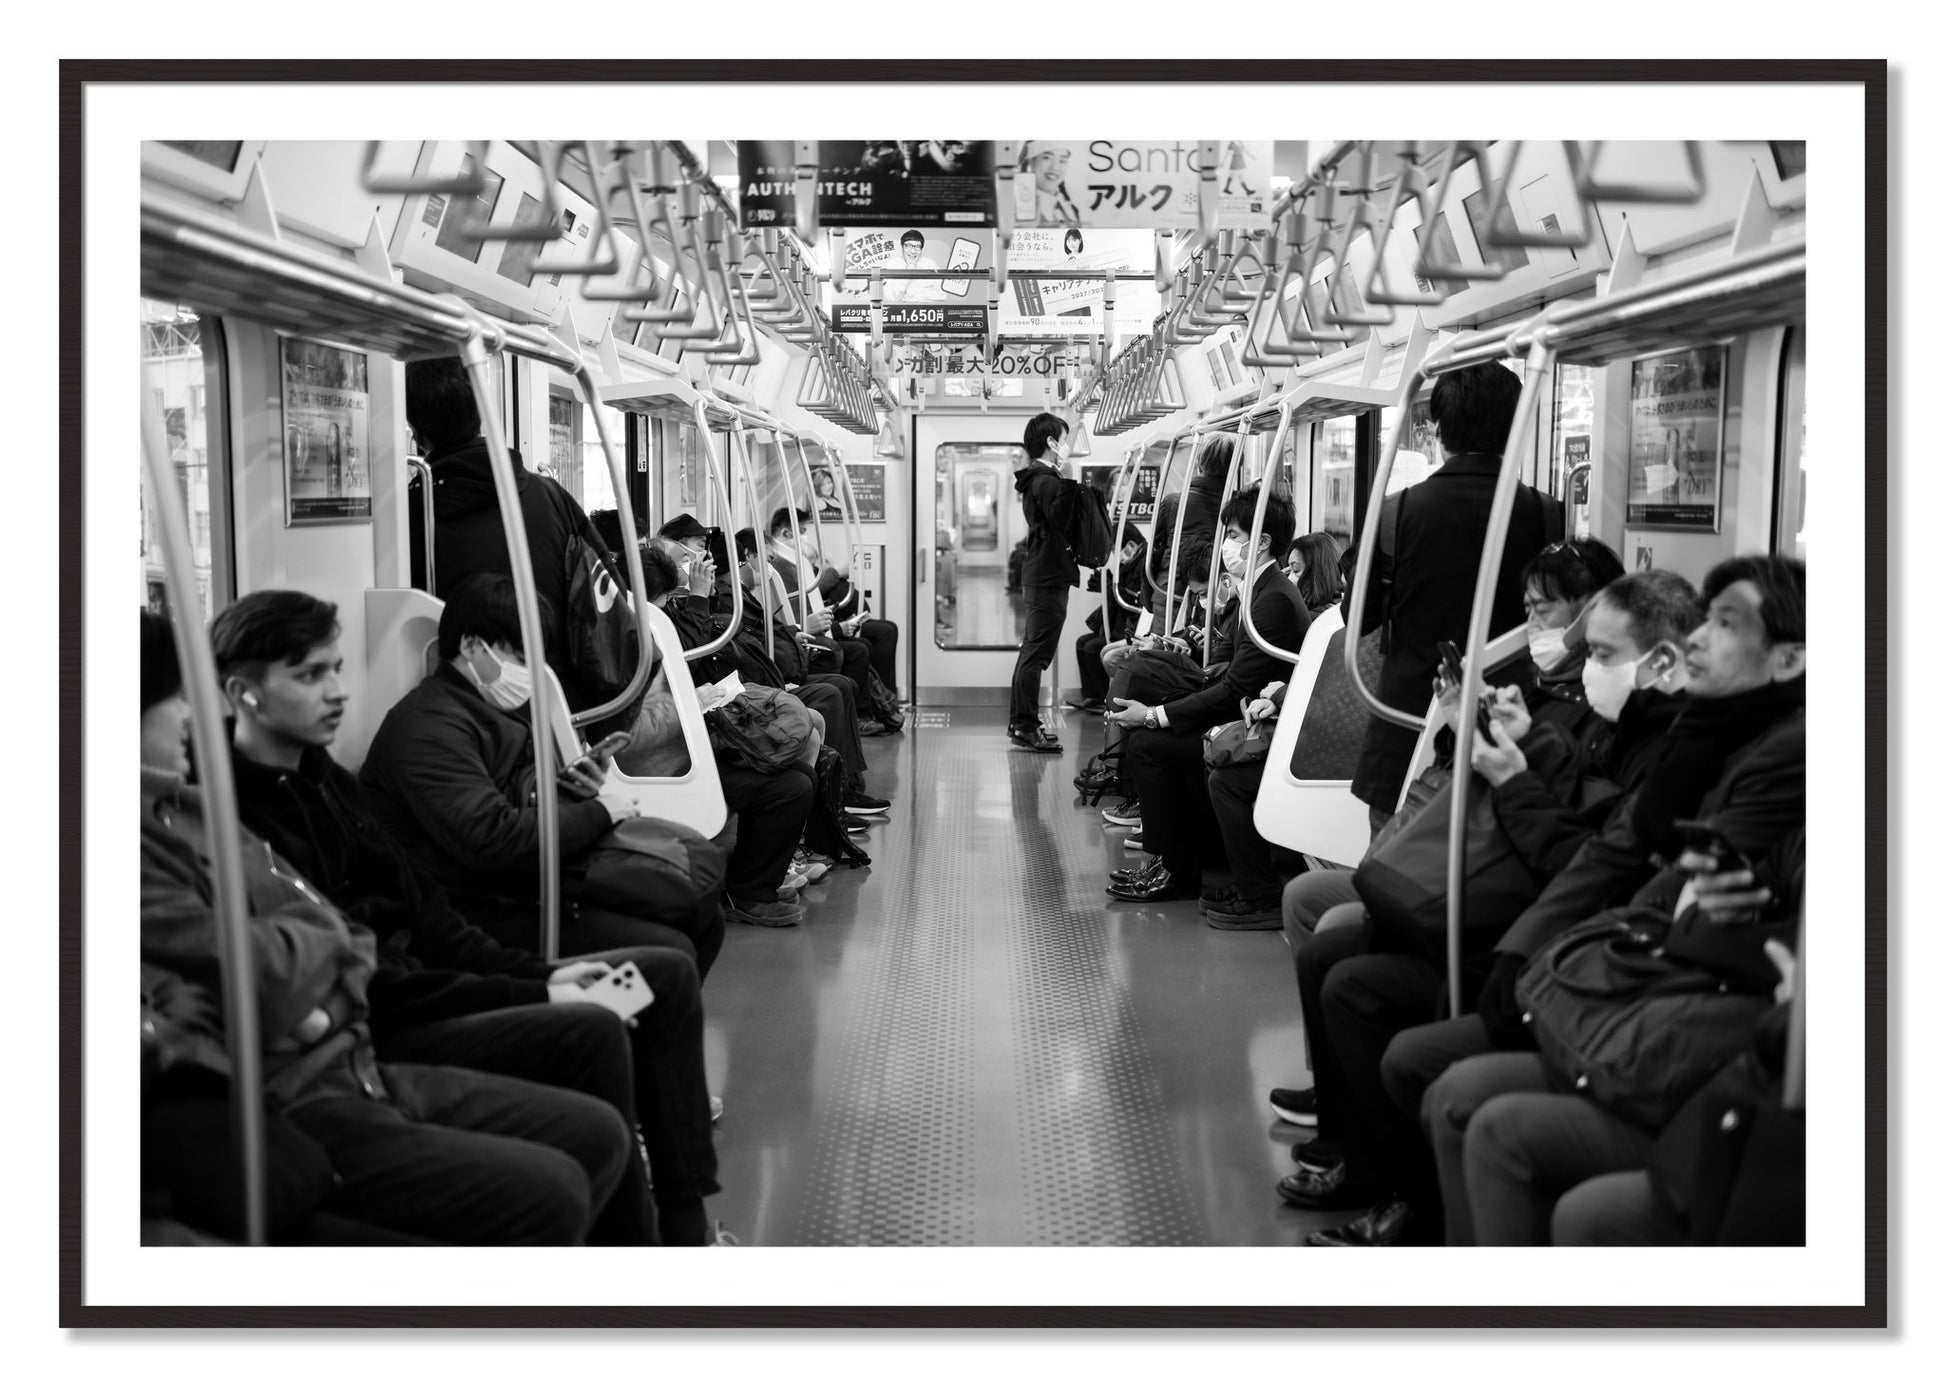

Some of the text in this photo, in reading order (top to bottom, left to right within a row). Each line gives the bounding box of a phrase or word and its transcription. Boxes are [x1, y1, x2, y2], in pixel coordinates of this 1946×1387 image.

[747, 182, 872, 196] AUTHNTECH
[1088, 184, 1173, 211] アルク
[1011, 232, 1053, 241] う会社に。
[1070, 287, 1104, 300] 2027/202
[1130, 503, 1155, 515] TBC
